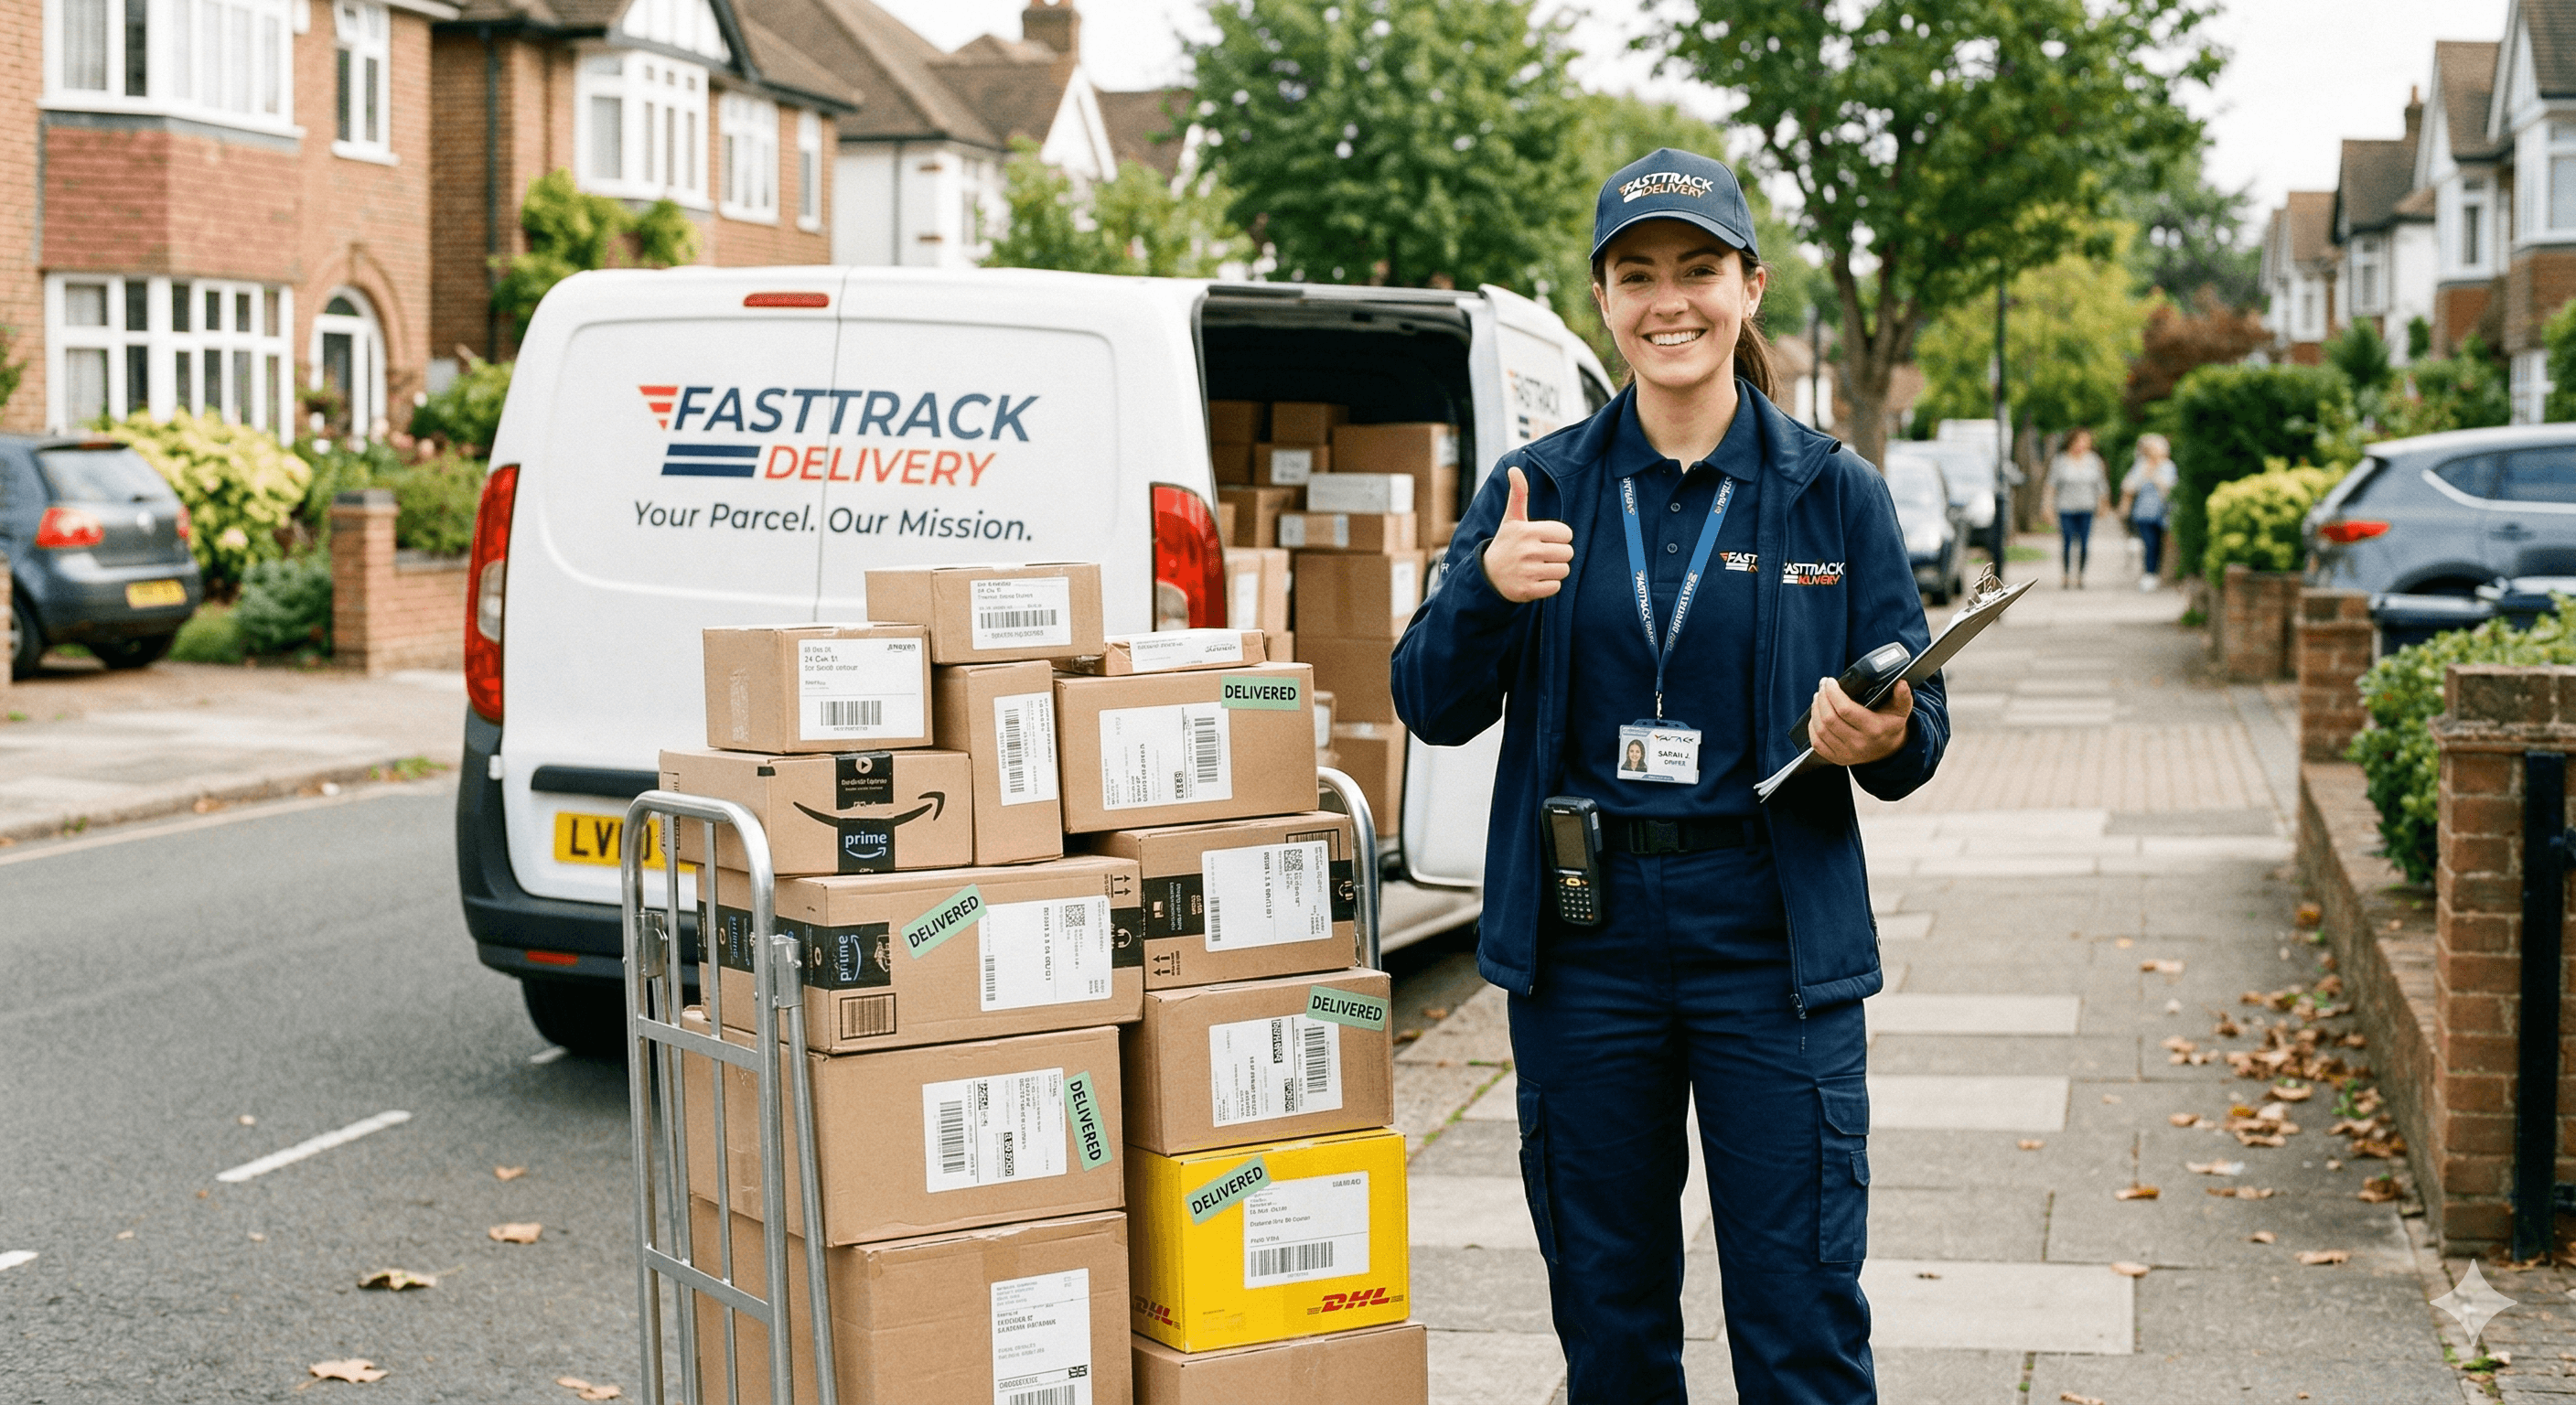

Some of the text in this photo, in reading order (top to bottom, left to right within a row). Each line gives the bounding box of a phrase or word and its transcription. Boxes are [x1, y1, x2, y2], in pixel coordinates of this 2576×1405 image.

[1624, 172, 1714, 196] FASTTRACK
[1642, 184, 1706, 198] DELIVERY
[673, 385, 1039, 443] FASTTRACK
[764, 444, 996, 488] DELIVERY
[635, 501, 1032, 542] Your Parcel. Our Mission.
[1225, 684, 1296, 701] DELIVERED
[845, 831, 887, 849] prime
[908, 896, 979, 948] DELIVERED
[1312, 995, 1382, 1021] DELIVERED
[1069, 1080, 1101, 1161] DELIVERED
[1191, 1166, 1263, 1215] DELIVERED
[1132, 1294, 1174, 1326] DHL
[1321, 1287, 1390, 1313] DHL
